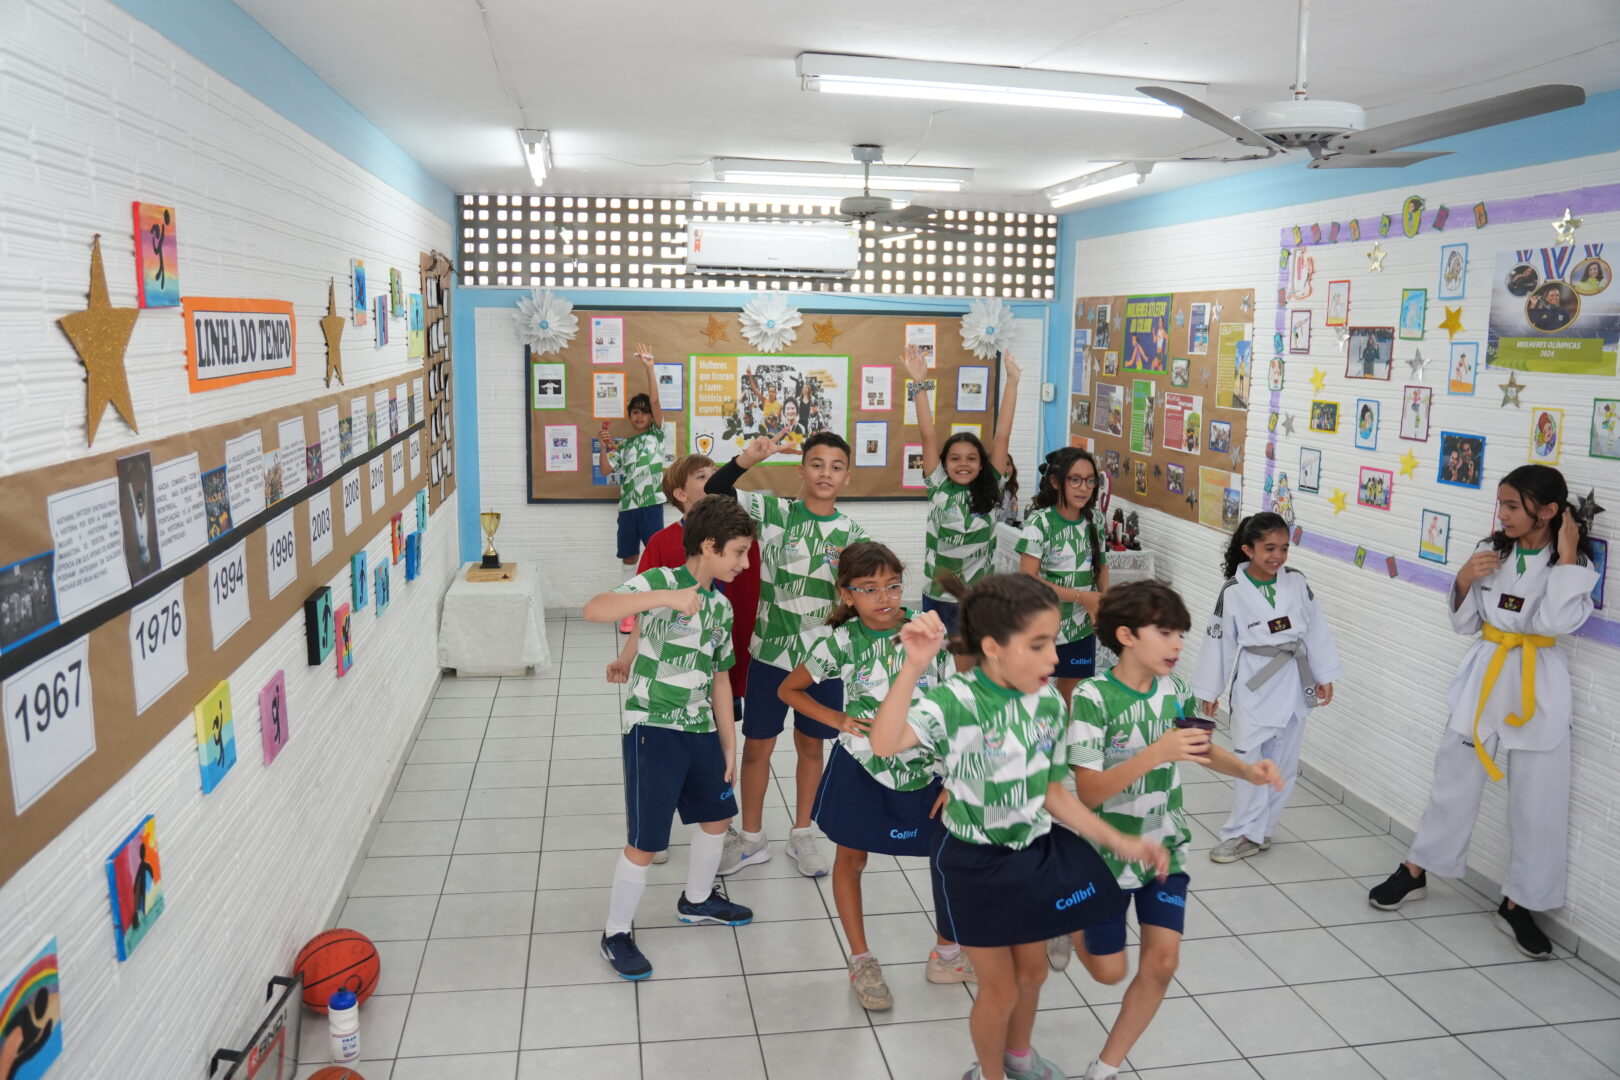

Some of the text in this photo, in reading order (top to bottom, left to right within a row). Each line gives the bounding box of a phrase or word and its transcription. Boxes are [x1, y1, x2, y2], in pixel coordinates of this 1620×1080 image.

[196, 319, 291, 367] LINHA DO TEMPO
[1516, 340, 1547, 348] MULHERES
[699, 372, 734, 382] que fizeram
[700, 360, 727, 370] Mulheres
[699, 393, 722, 402] história
[704, 382, 723, 392] fazem
[699, 405, 722, 414] esporte
[392, 450, 403, 473] 2020
[410, 440, 420, 460] 2024
[371, 464, 384, 490] 2016
[344, 478, 360, 508] 2008
[312, 508, 331, 542] 2003
[270, 532, 294, 570] 1996
[213, 555, 244, 606] 1994
[136, 601, 182, 660] 1976
[14, 660, 83, 743] 1967
[890, 828, 918, 840] Colibri
[1056, 882, 1096, 910] Colibri
